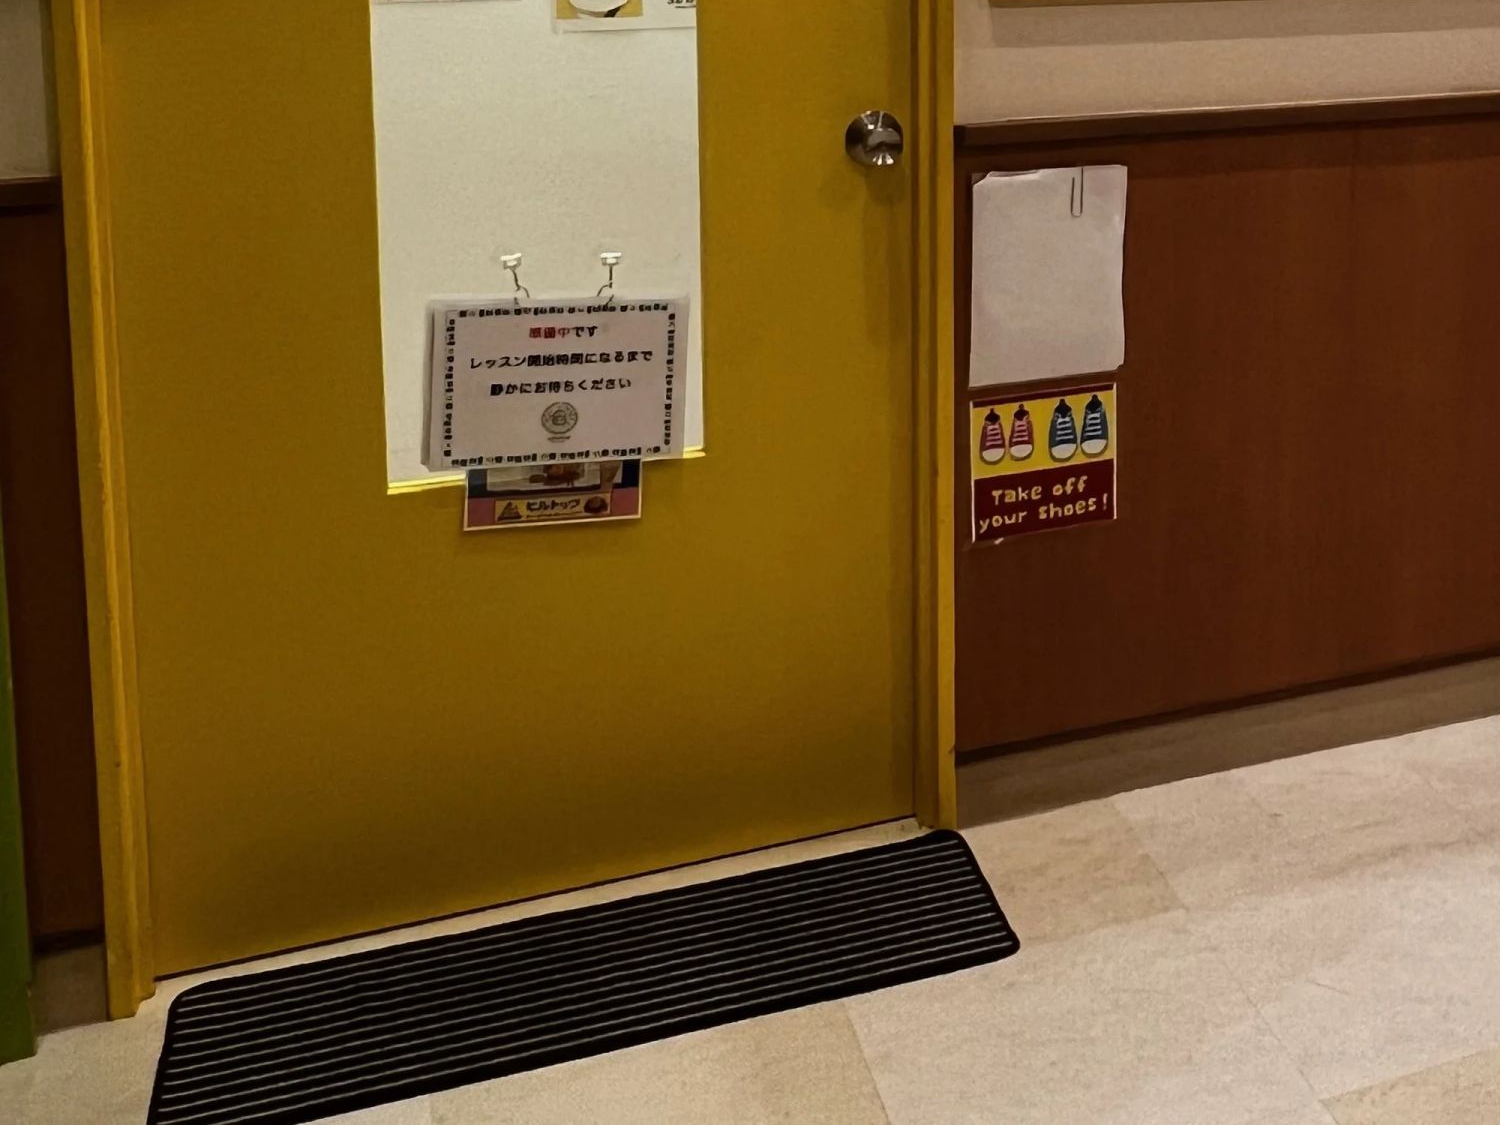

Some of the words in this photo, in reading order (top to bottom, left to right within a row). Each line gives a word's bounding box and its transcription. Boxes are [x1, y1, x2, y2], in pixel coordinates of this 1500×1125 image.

[469, 350, 654, 370] レッスン開始時間になるまで
[489, 377, 632, 397] 静かにお待ちください
[991, 484, 1043, 506] Take
[1052, 475, 1089, 497] off
[979, 510, 1028, 534] your
